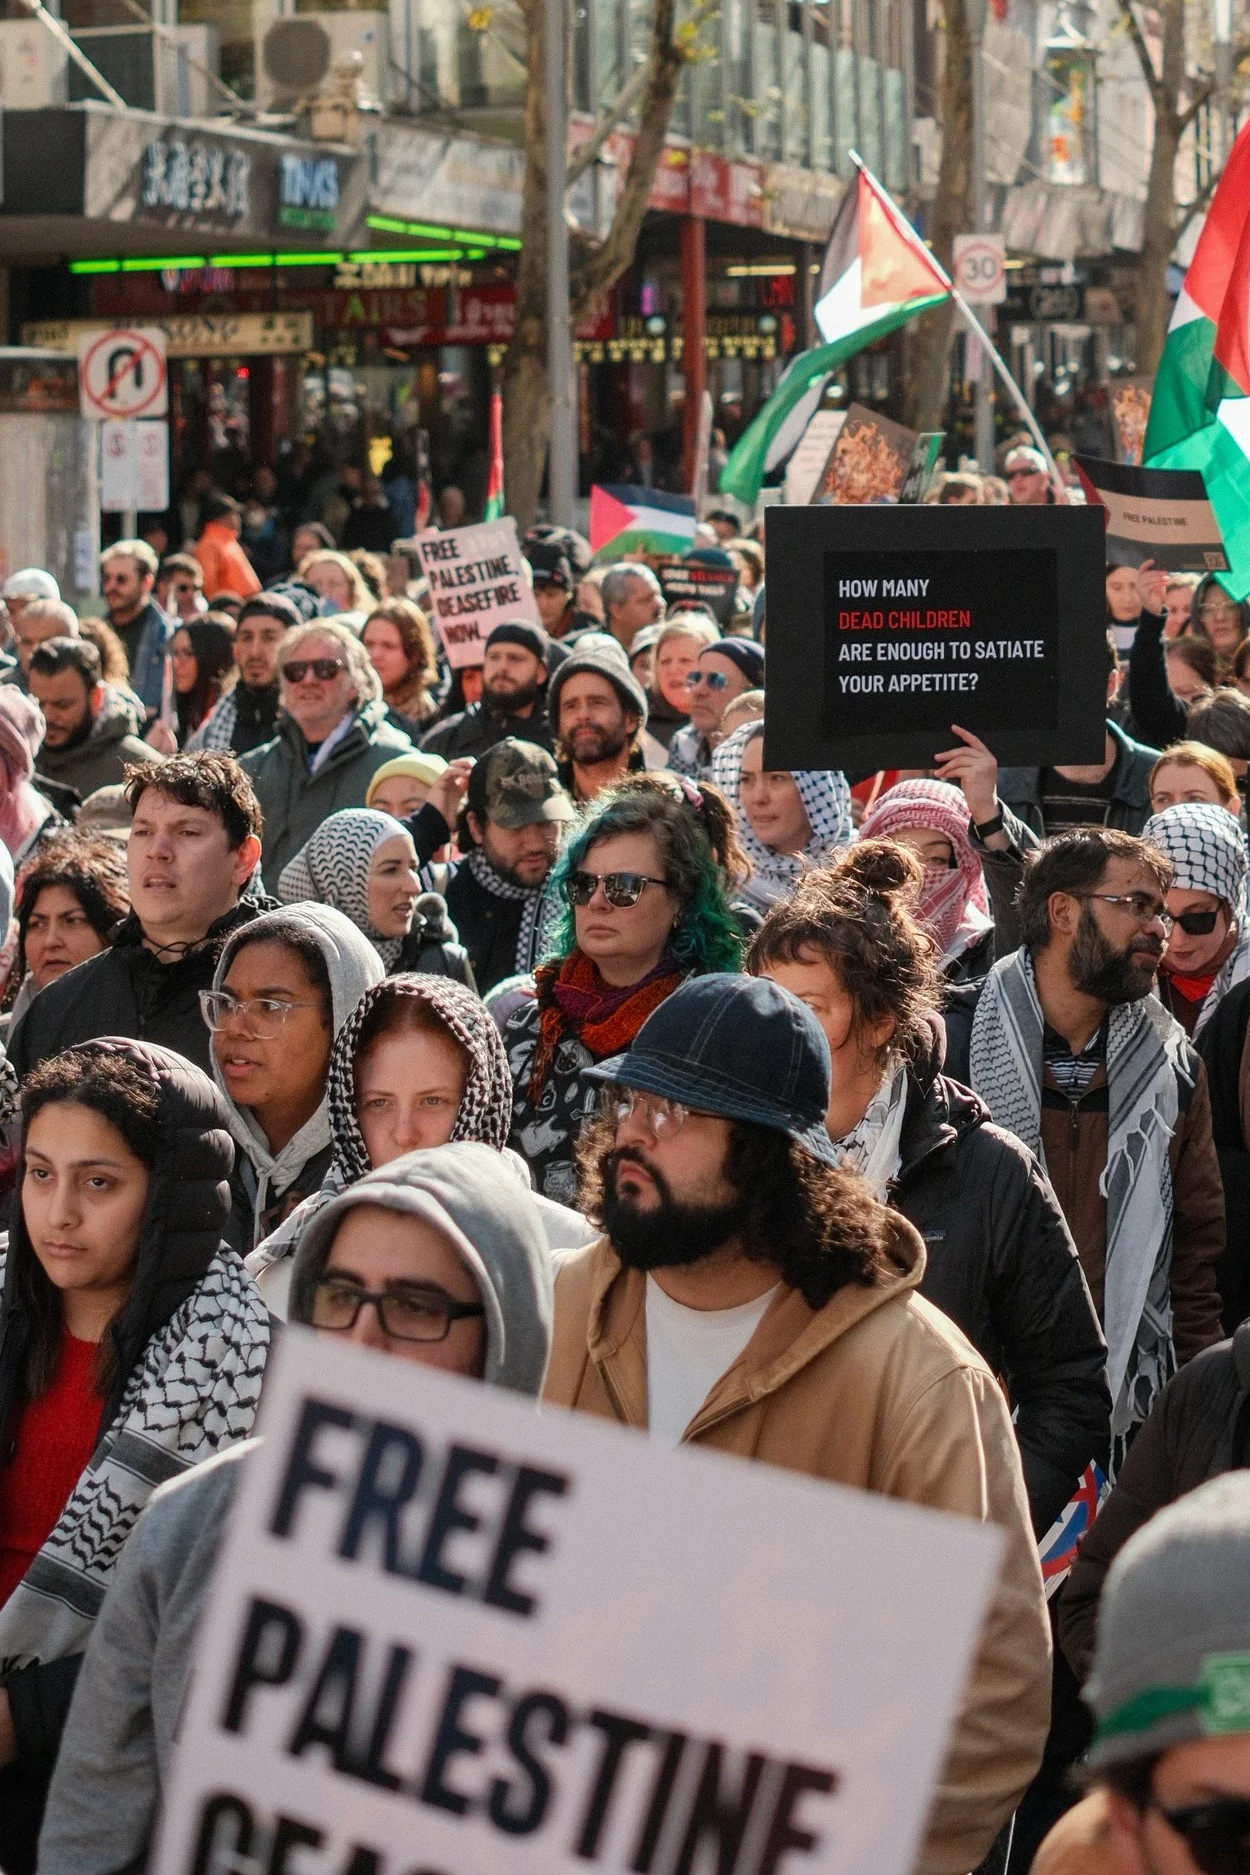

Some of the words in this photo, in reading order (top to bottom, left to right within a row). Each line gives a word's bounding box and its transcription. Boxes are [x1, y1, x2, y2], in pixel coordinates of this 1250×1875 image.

[964, 256, 995, 281] 30
[1122, 512, 1141, 524] FREE
[1142, 515, 1188, 526] PALESTINE
[421, 538, 461, 563] FREE
[838, 579, 878, 598] HOW
[881, 579, 930, 598] MANY
[838, 611, 884, 630] DEAD
[888, 610, 972, 629] CHILDREN
[838, 642, 873, 662] ARE
[876, 641, 945, 661] ENOUGH
[948, 641, 971, 660] TO
[974, 639, 1045, 659] SATIATE
[838, 674, 885, 694] YOUR
[887, 672, 979, 693] APPETITE?
[267, 1395, 573, 1619] FREE
